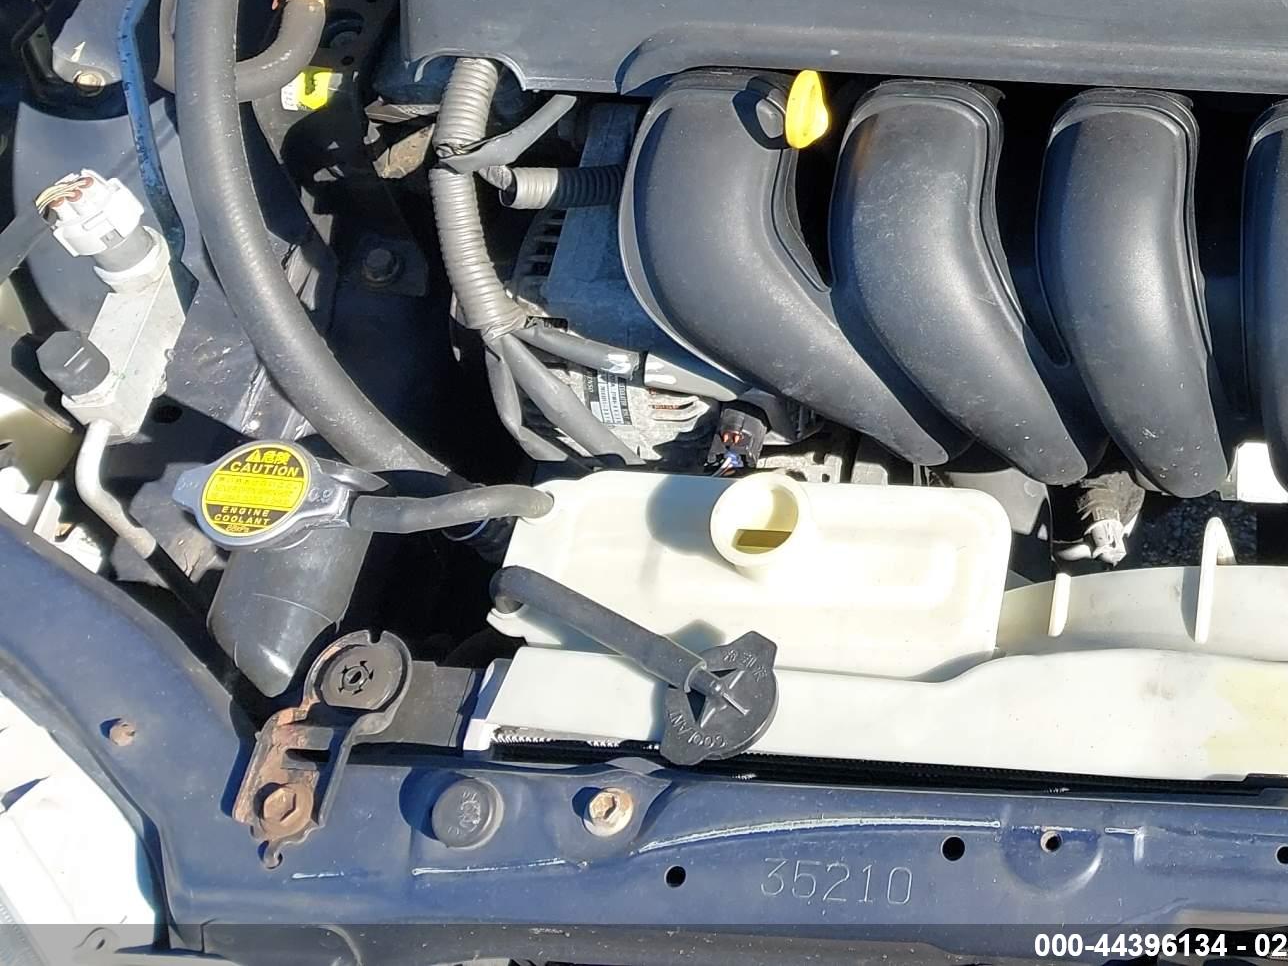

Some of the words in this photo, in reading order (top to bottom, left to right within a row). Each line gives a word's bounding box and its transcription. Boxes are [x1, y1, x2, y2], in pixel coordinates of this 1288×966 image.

[230, 461, 300, 478] CAUTION
[221, 506, 271, 517] ENGINE
[214, 514, 271, 525] COOLANT
[760, 857, 913, 905] 35210
